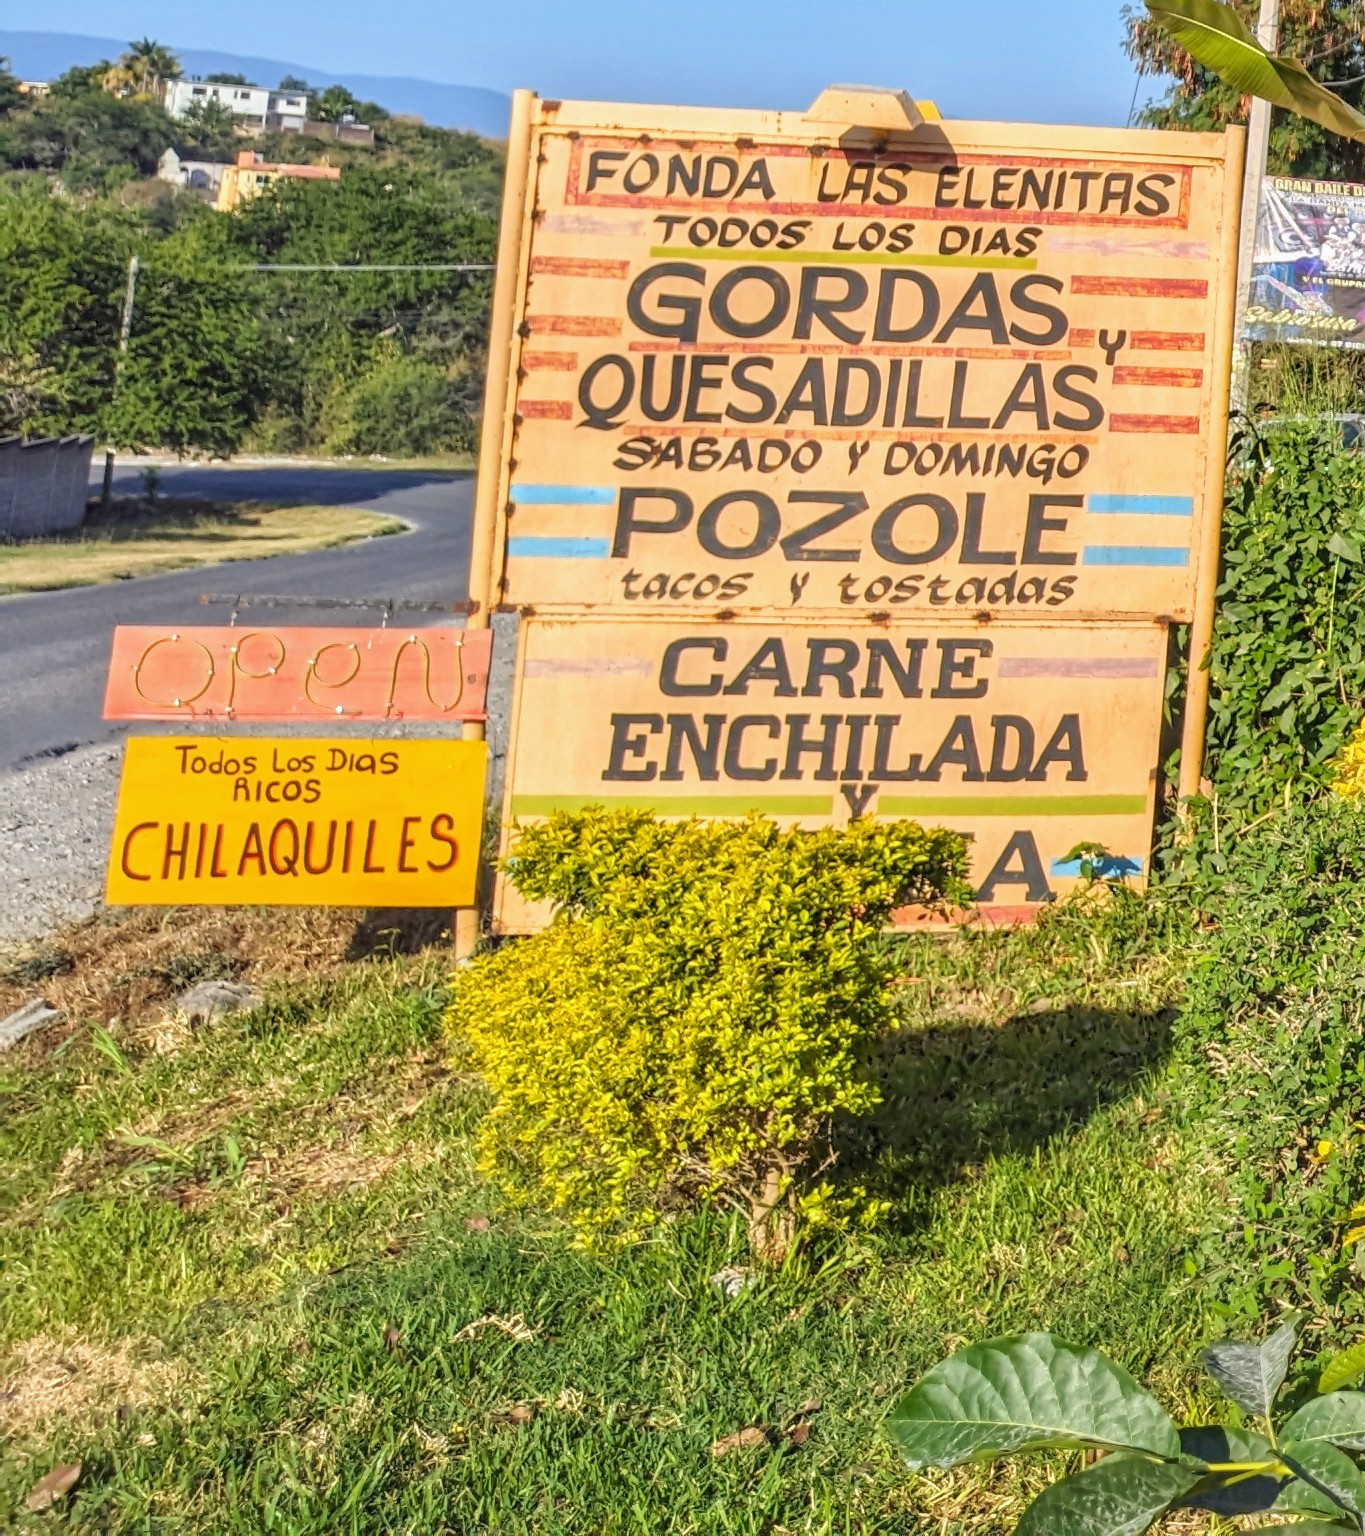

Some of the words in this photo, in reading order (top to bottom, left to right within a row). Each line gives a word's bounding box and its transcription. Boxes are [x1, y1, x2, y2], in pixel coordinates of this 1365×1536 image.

[586, 150, 777, 201] FONDA
[817, 161, 912, 206] LAS
[935, 164, 1176, 217] ELENITAS
[1274, 177, 1312, 193] GRAN
[1314, 182, 1351, 197] BAILE
[653, 214, 812, 250] TODOS
[833, 221, 916, 253] LOS
[938, 224, 1044, 258] DIAS
[626, 261, 1069, 347] GORDAS
[1098, 329, 1127, 365] Y
[574, 352, 1105, 432] QUESADILLAS
[612, 435, 823, 474] SABADO
[848, 439, 871, 475] Y
[883, 439, 1090, 485] DOMINGO
[611, 486, 1085, 566] POZOLE
[621, 568, 754, 601] tacos
[838, 569, 1079, 606] tostadas
[658, 635, 995, 700] CARNE
[175, 744, 258, 775] Todos
[272, 747, 317, 774] Los
[601, 712, 1089, 783] ENCHILADA
[121, 812, 459, 881] CHILAQUILES
